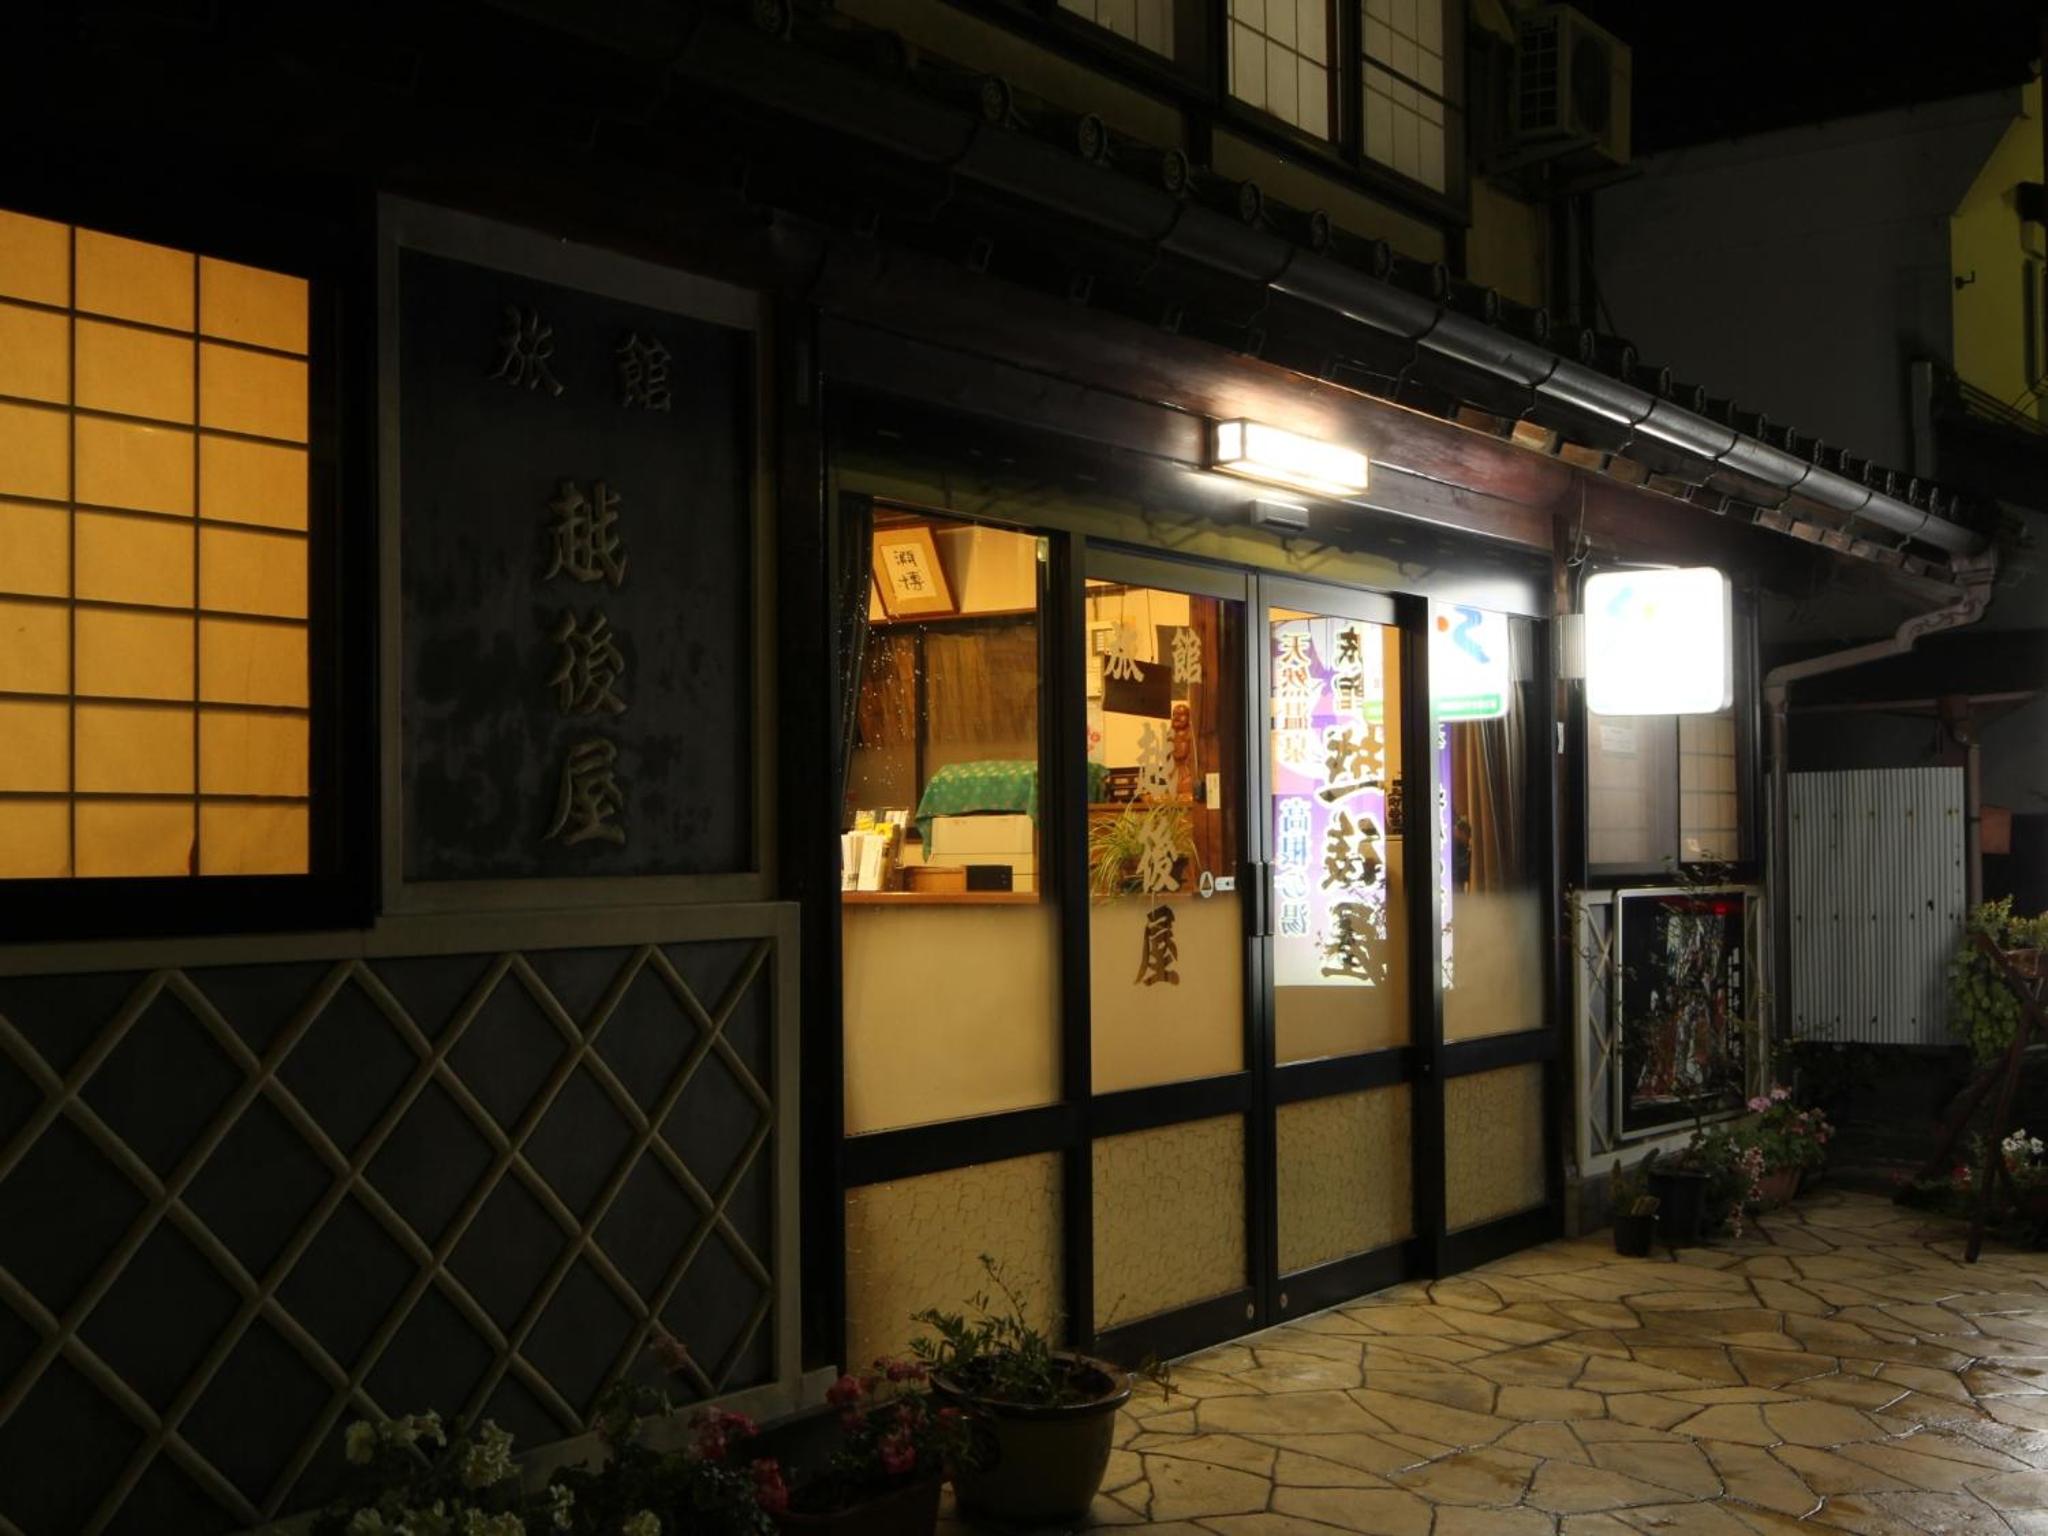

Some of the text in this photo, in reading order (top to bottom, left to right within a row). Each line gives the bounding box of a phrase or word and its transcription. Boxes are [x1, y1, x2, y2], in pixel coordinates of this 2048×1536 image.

[489, 304, 672, 412] 旅館
[541, 480, 631, 847] 越後屋
[1103, 619, 1203, 684] 旅館
[1134, 721, 1181, 986] 越後屋
